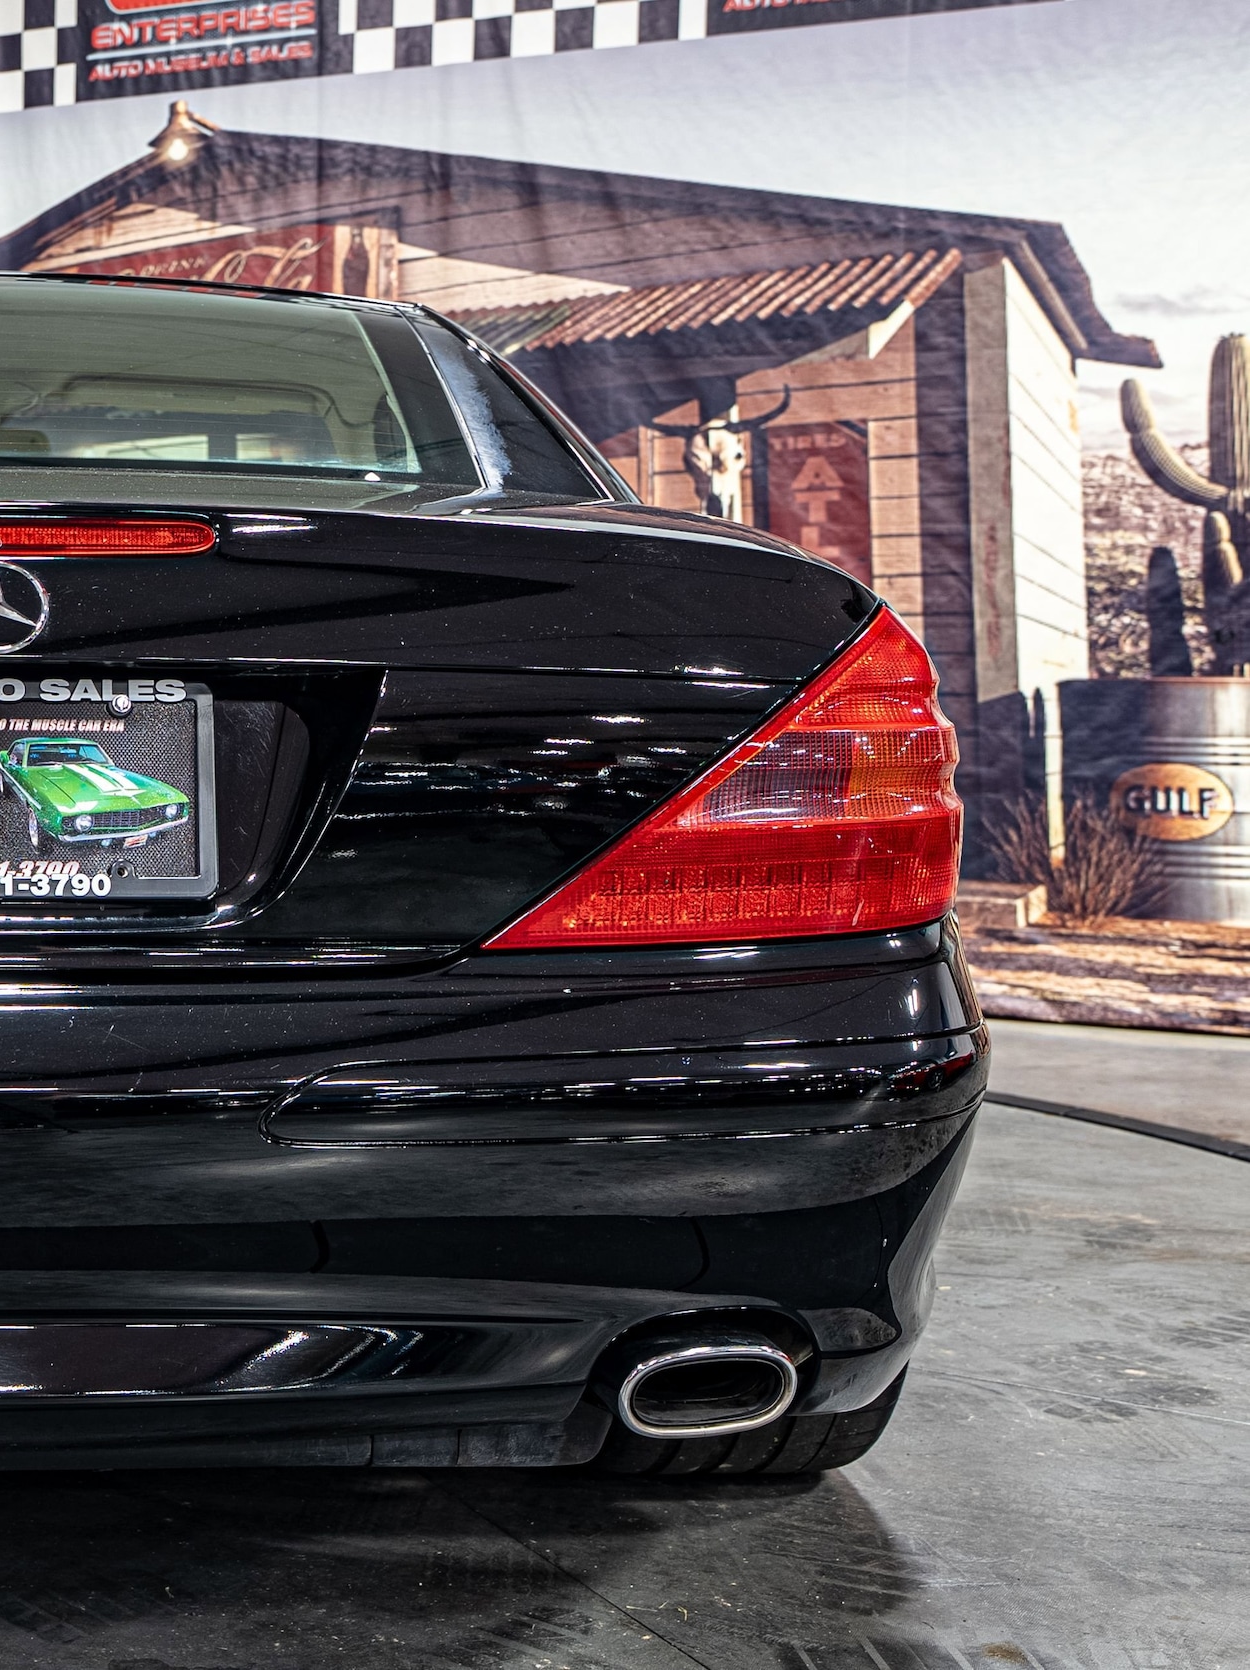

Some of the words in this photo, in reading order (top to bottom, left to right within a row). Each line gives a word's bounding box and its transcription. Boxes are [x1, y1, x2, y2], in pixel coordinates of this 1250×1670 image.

[90, 1, 316, 49] ENTERPRISES
[88, 60, 144, 82] AUTO
[145, 52, 230, 76] MUSEUM
[246, 41, 313, 65] SALES
[770, 432, 848, 450] TIRES
[39, 678, 187, 702] SALES
[9, 718, 30, 731] THE
[31, 718, 77, 732] MUSCLE
[78, 719, 101, 732] CAR
[102, 719, 126, 732] ERA
[1124, 785, 1220, 819] GULF
